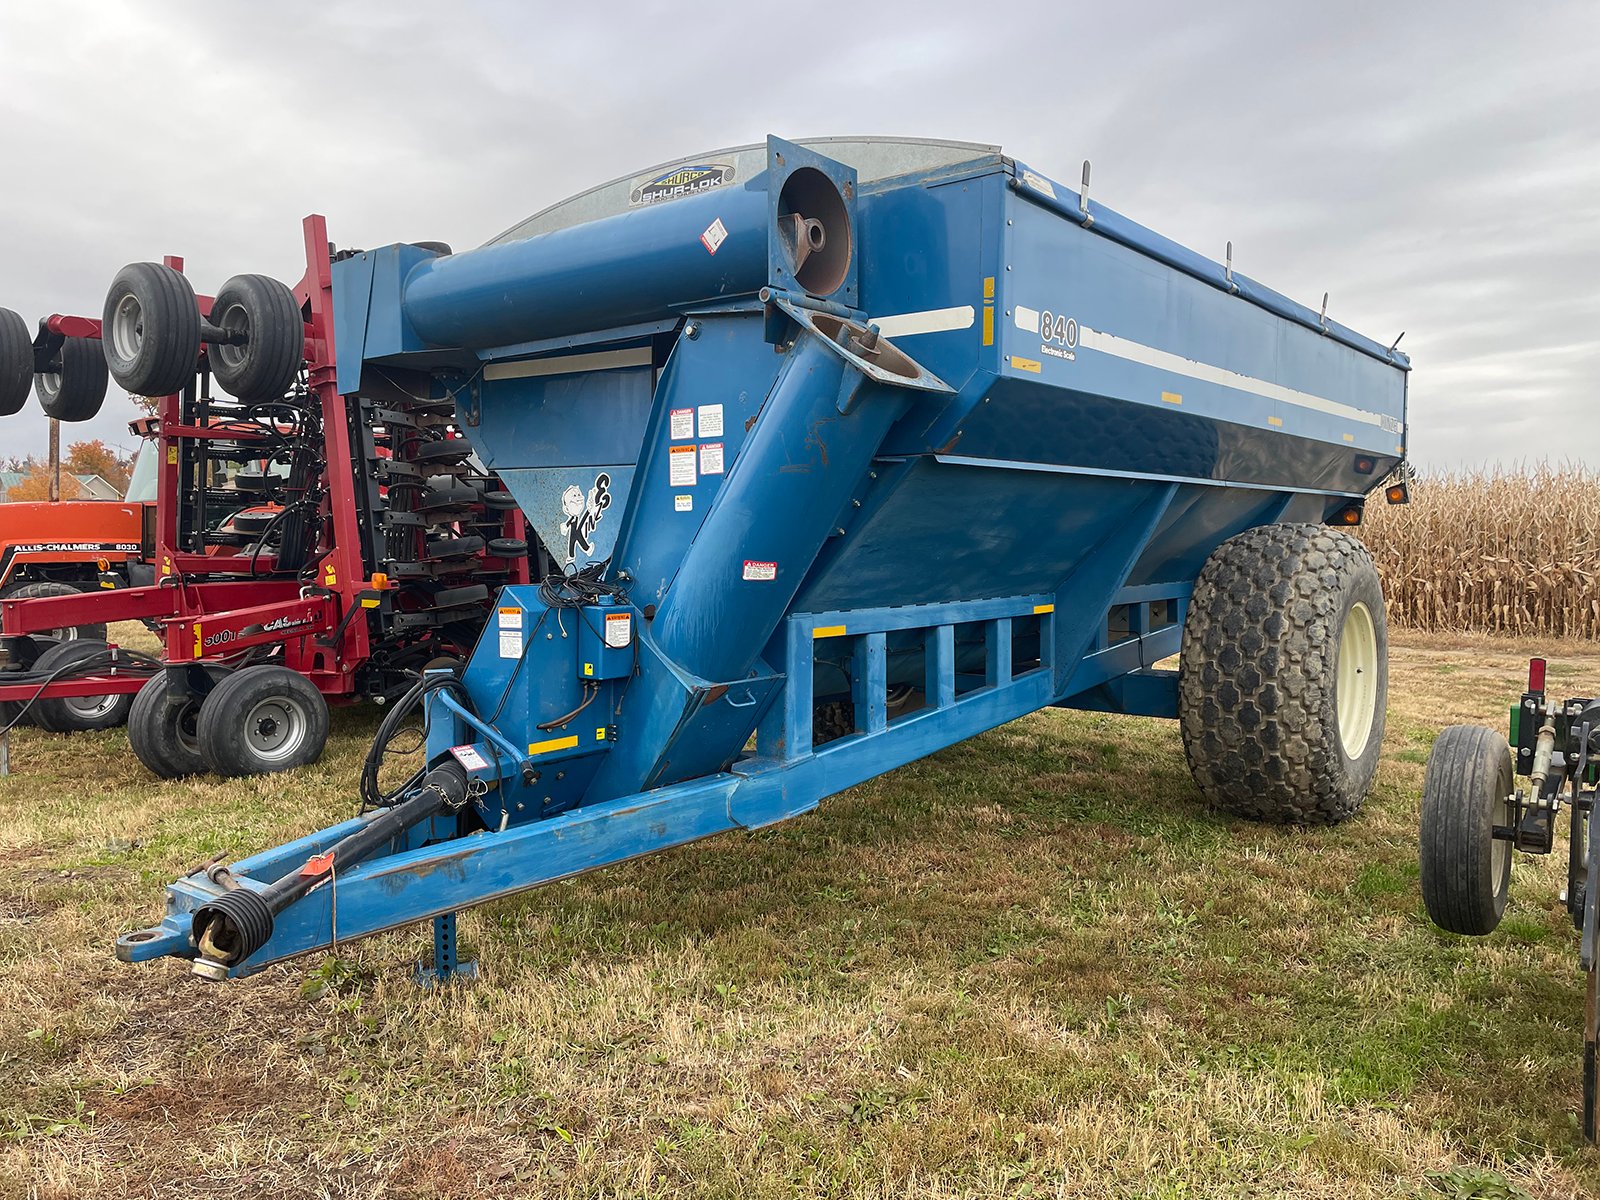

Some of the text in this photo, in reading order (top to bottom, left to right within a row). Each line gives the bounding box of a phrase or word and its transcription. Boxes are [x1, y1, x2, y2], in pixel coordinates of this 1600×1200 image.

[642, 176, 721, 202] SHUR-LOK
[1041, 310, 1077, 349] 840
[1041, 344, 1075, 361] Electronic Scale
[564, 473, 611, 560] KINZE
[14, 544, 100, 552] ALLIS-CHALMERS
[263, 616, 301, 631] CAS
